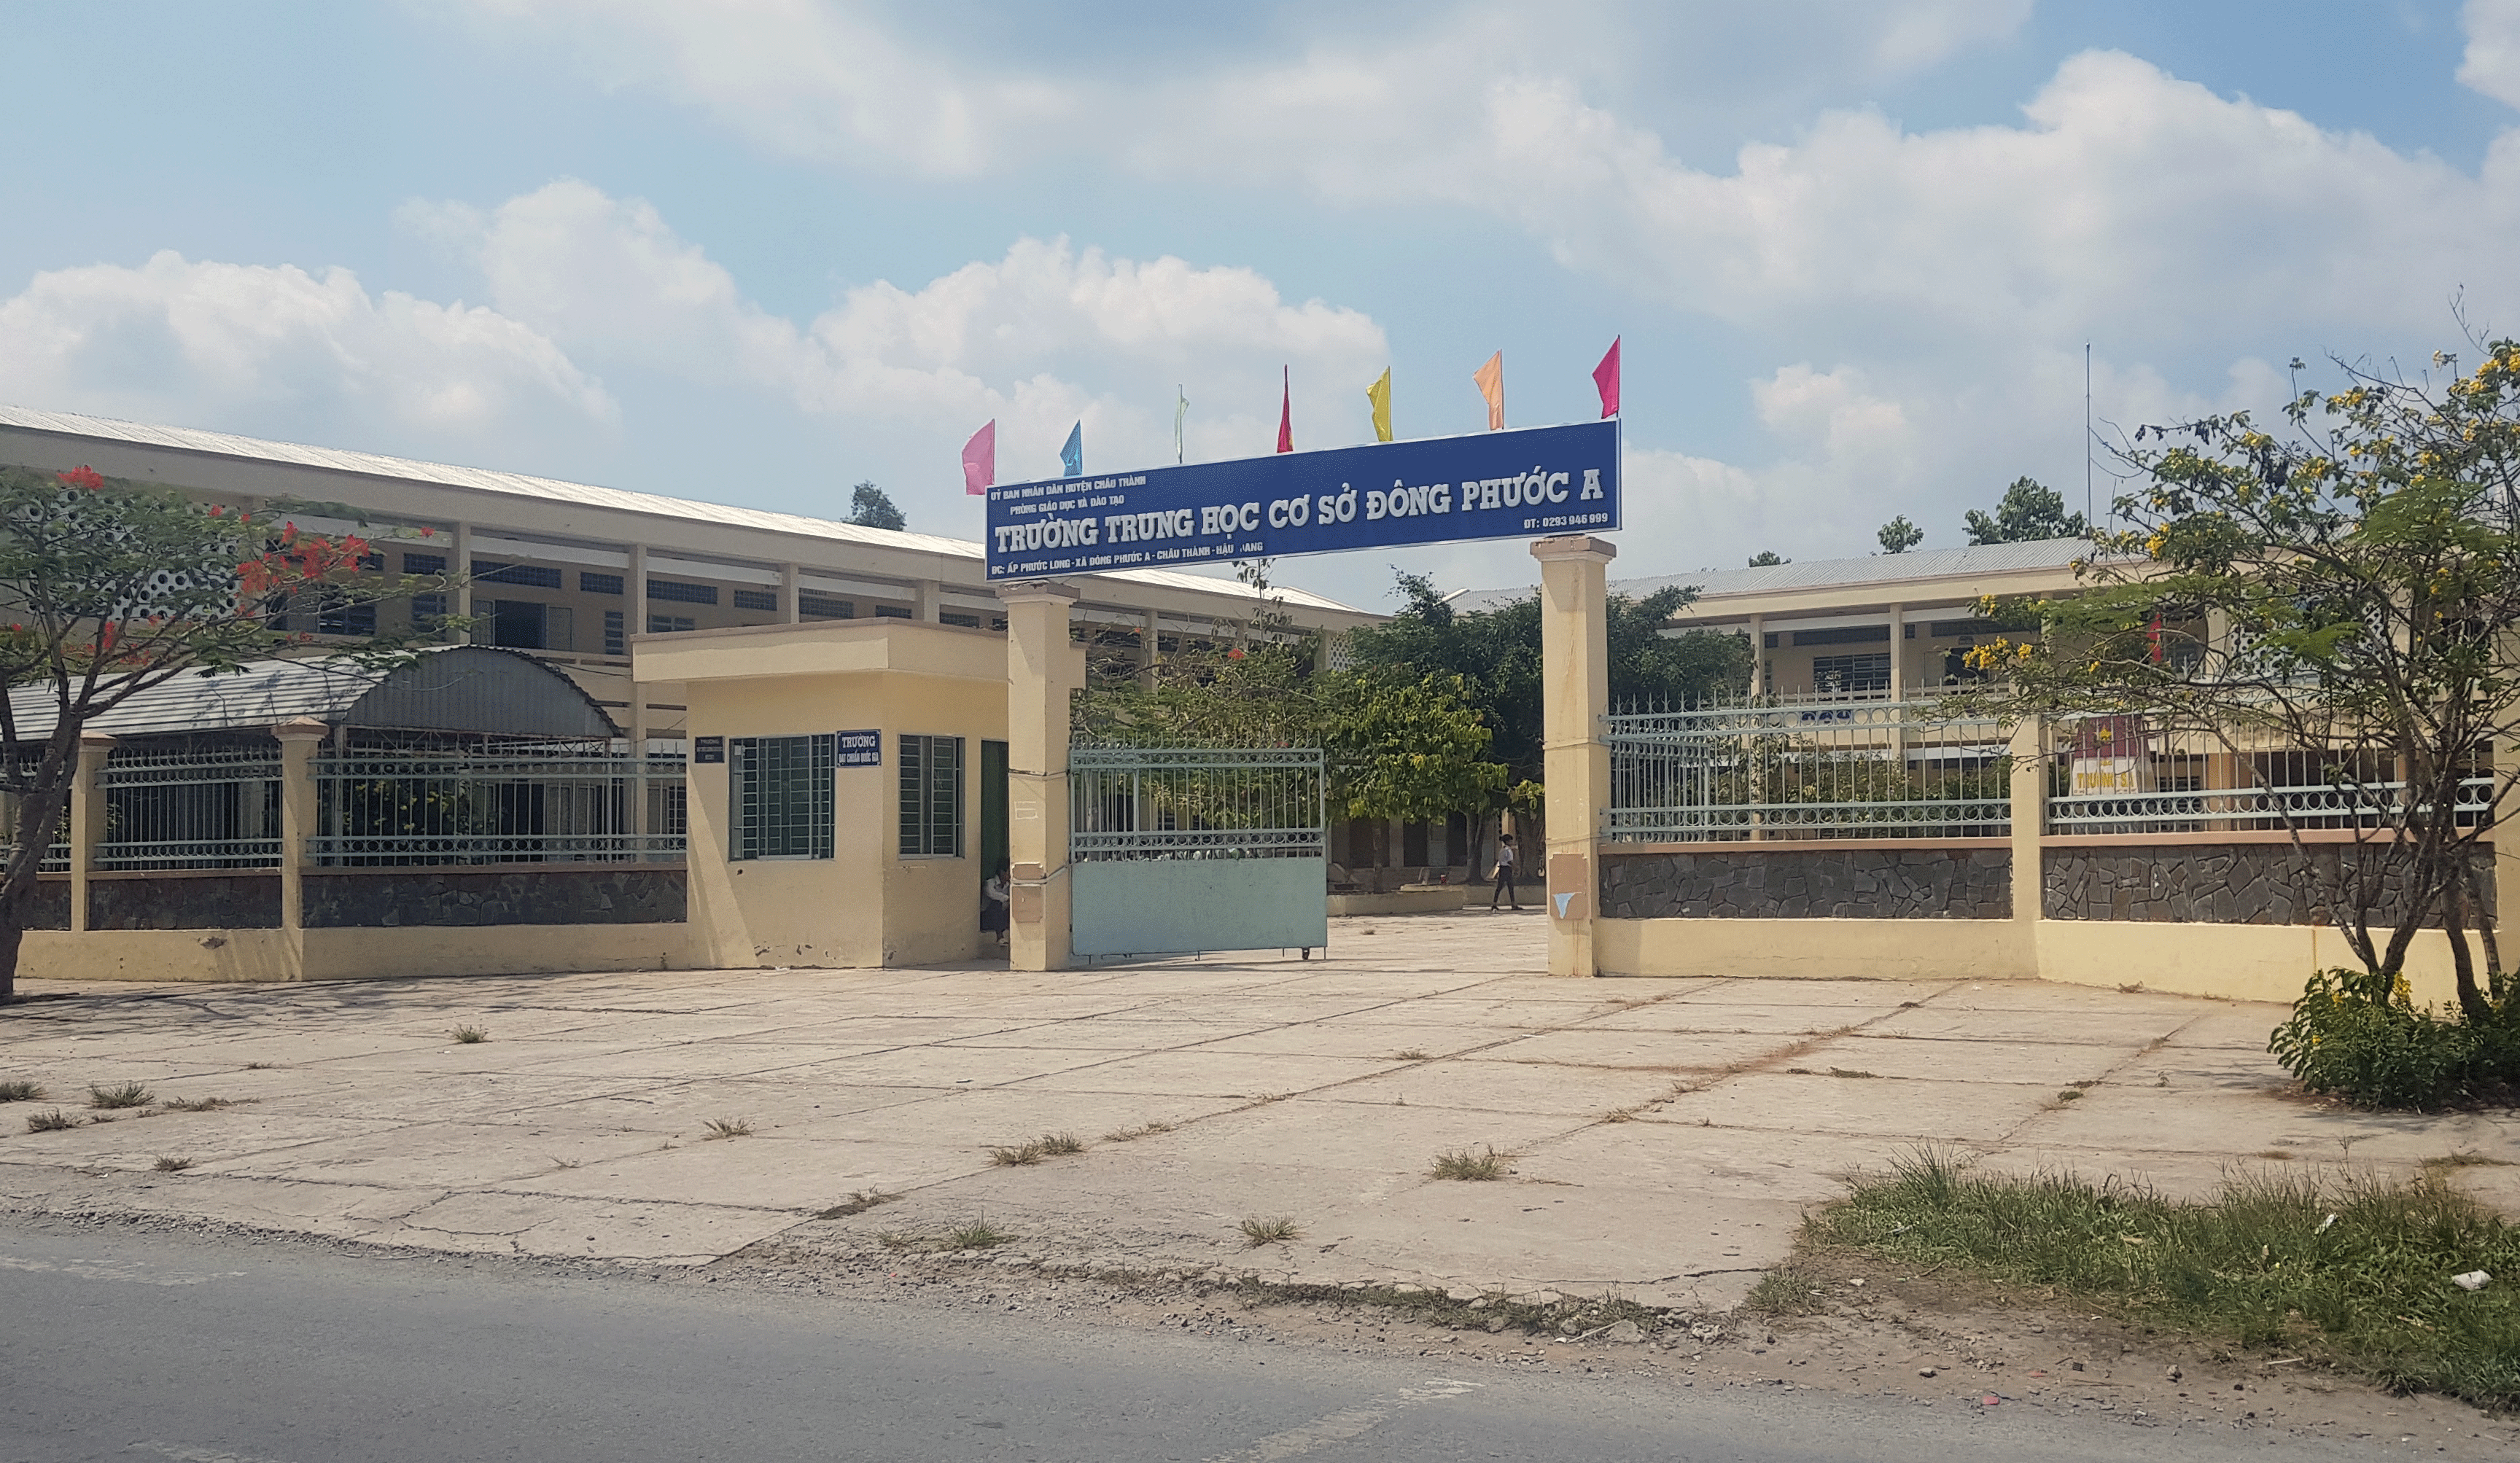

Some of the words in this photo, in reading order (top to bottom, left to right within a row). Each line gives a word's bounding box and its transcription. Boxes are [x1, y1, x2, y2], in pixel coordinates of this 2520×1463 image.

[1003, 490, 1020, 500] BAN
[1022, 485, 1044, 498] NHÂN
[1046, 483, 1064, 495] DÂN
[1065, 480, 1092, 493] HUYỆN
[1094, 477, 1116, 490] CHÂU
[1119, 475, 1146, 488] THÀNH
[995, 512, 1100, 553] TRƯỜNG
[1105, 508, 1195, 543] TRUNG
[1201, 502, 1260, 539] HỌC
[1269, 494, 1310, 528] CƠ
[1318, 482, 1358, 525] SỞ
[1366, 479, 1452, 520] ĐÔNG
[1461, 466, 1570, 511] PHƯỚC
[1580, 469, 1604, 501] A
[1010, 503, 1037, 515] PHÒNG
[1039, 500, 1058, 512] GIÁO
[1059, 500, 1076, 512] DỤC
[1077, 496, 1088, 508] VÀ
[1090, 496, 1107, 507] ĐÀO
[1109, 495, 1124, 507] TẠO
[1524, 518, 1540, 529] ĐT:
[1542, 516, 1567, 527] 0293
[1568, 514, 1588, 526] 946
[1590, 512, 1609, 523] 999
[1021, 560, 1048, 572] PHƯỚC
[1089, 555, 1112, 566] ĐÔNG
[1113, 551, 1143, 563] PHƯỚC
[1144, 552, 1151, 561] A
[1156, 548, 1180, 560] CHÂU
[1181, 545, 1210, 558] THÀNH
[1216, 543, 1234, 555] HẬU
[842, 733, 876, 748] TRƯỜNG
